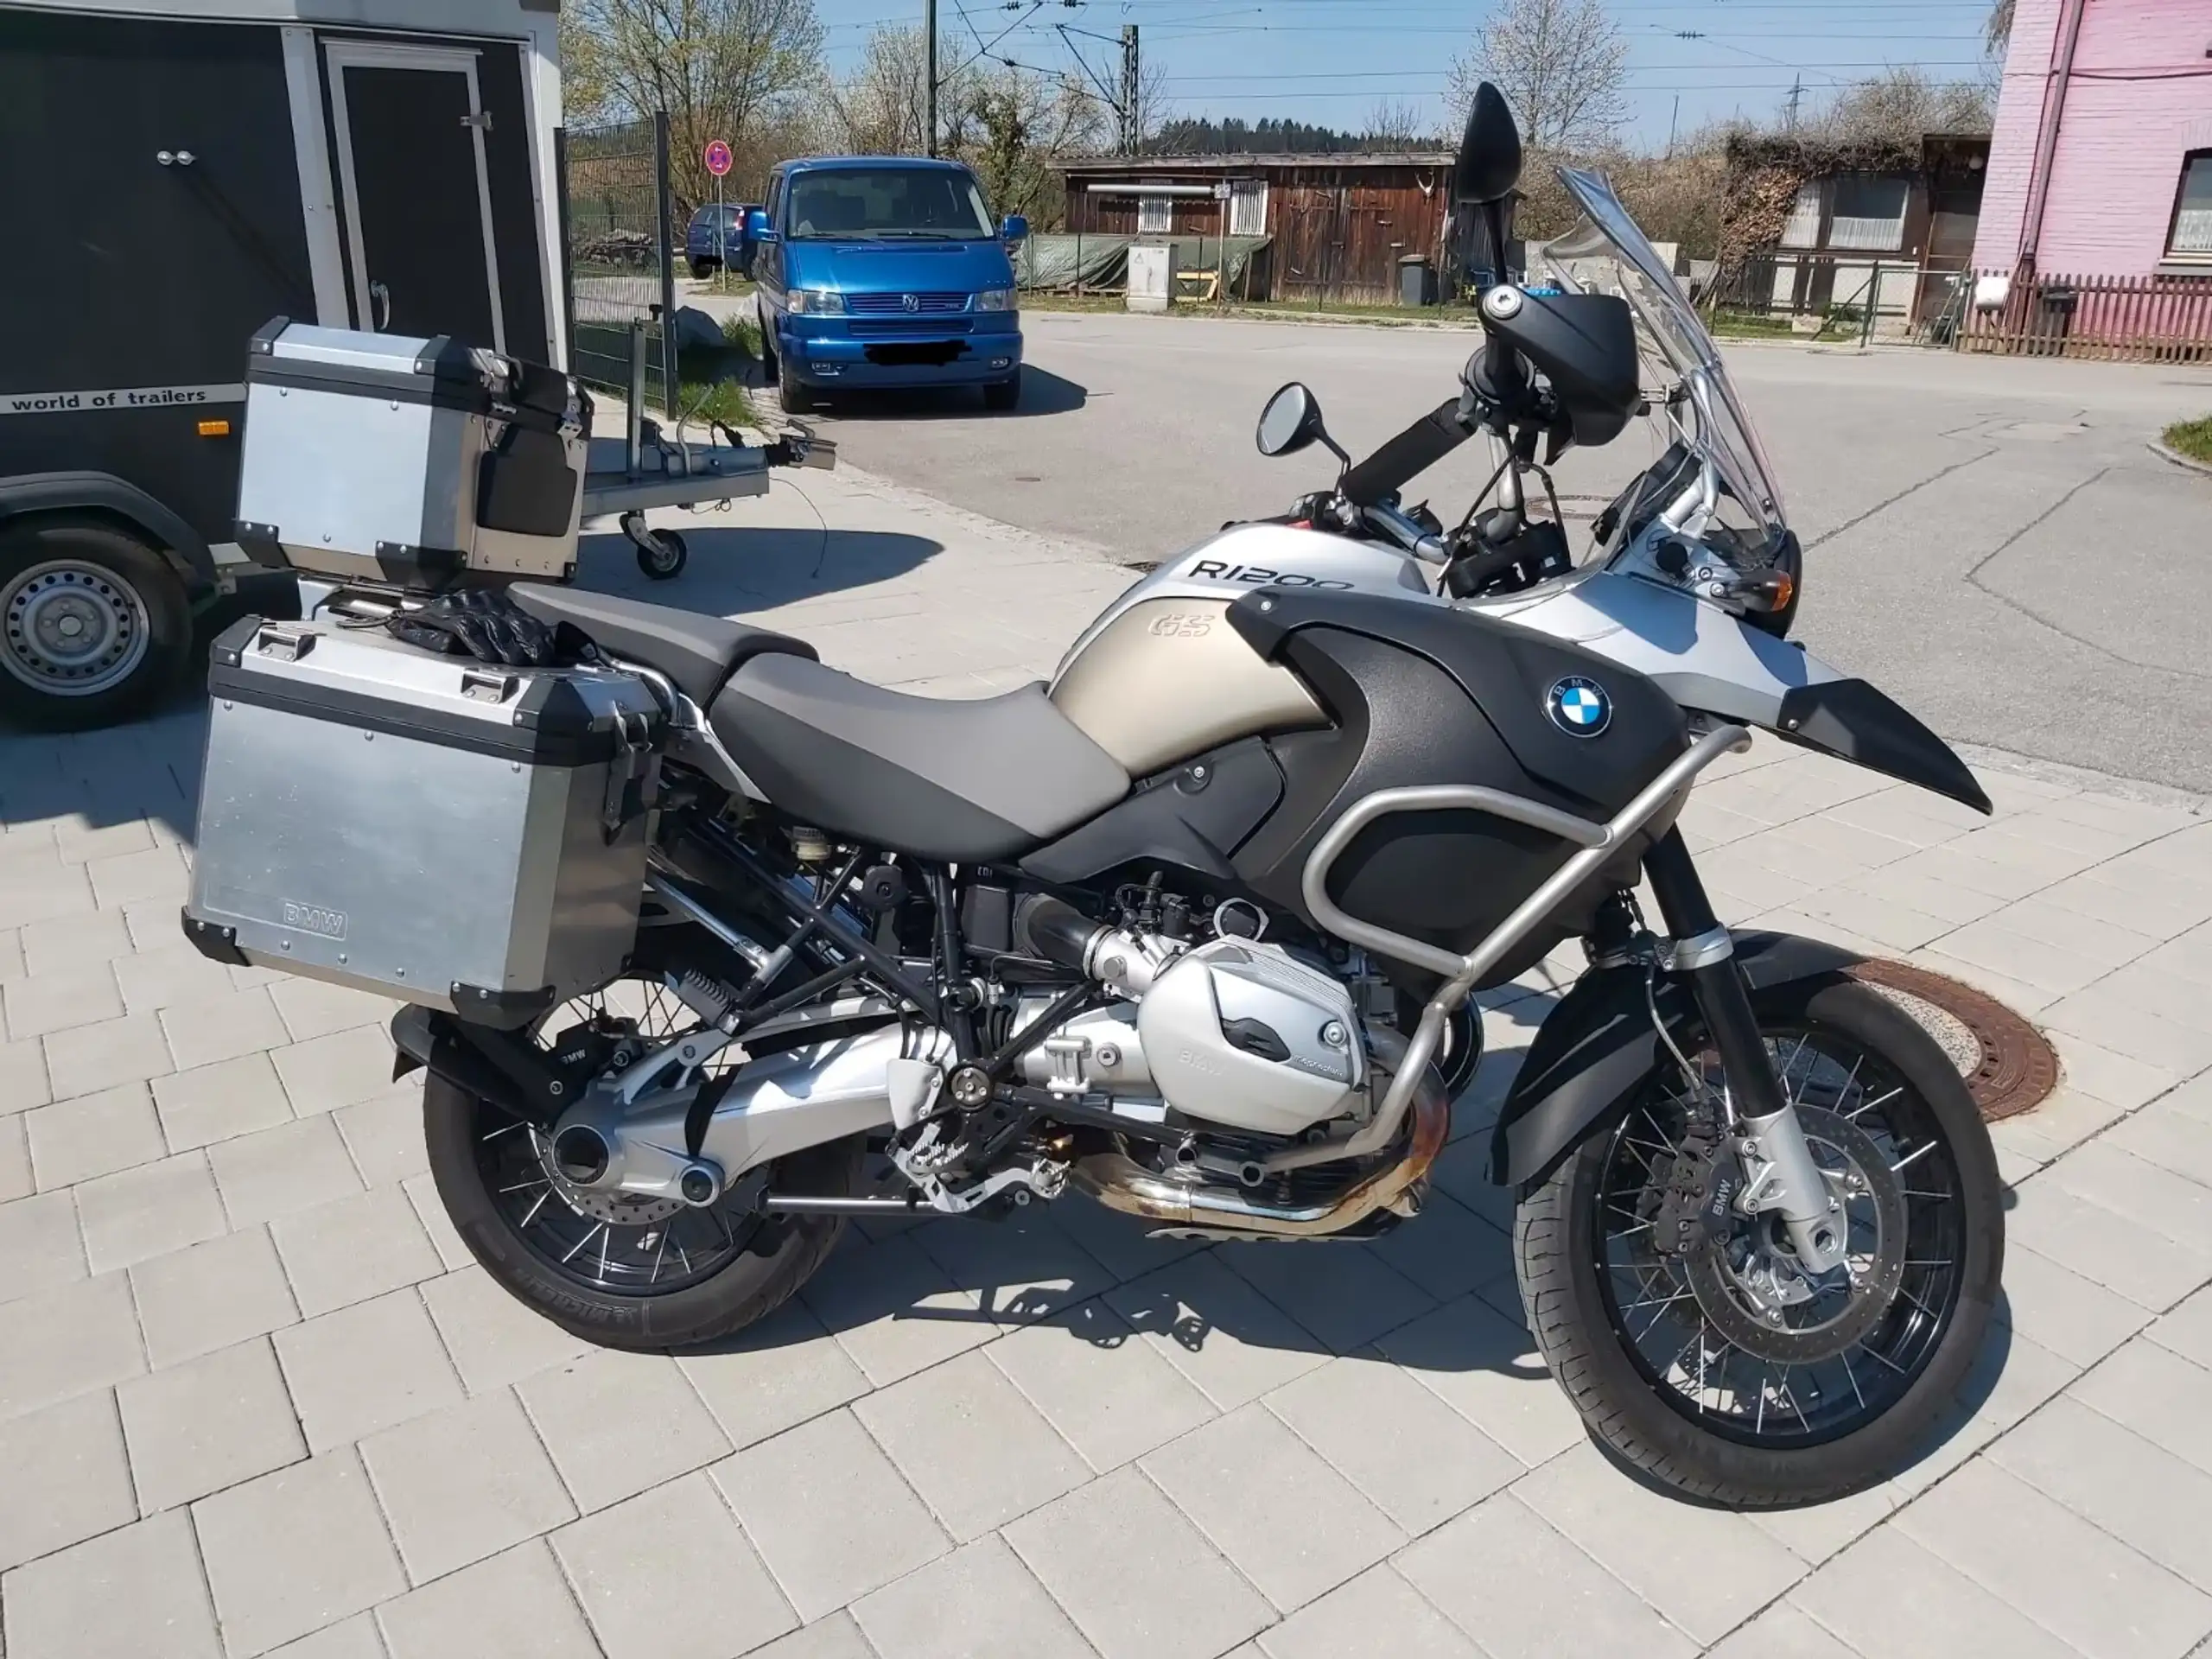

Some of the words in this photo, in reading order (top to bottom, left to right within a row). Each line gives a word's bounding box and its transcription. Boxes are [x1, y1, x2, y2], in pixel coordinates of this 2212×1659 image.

[11, 395, 79, 410] world
[92, 392, 117, 407] of
[128, 390, 207, 405] trailers
[1188, 560, 1355, 590] R1200
[1147, 613, 1217, 637] GS
[1554, 678, 1603, 696] BMW
[283, 902, 344, 934] BMW
[1712, 1179, 1732, 1217] BMW
